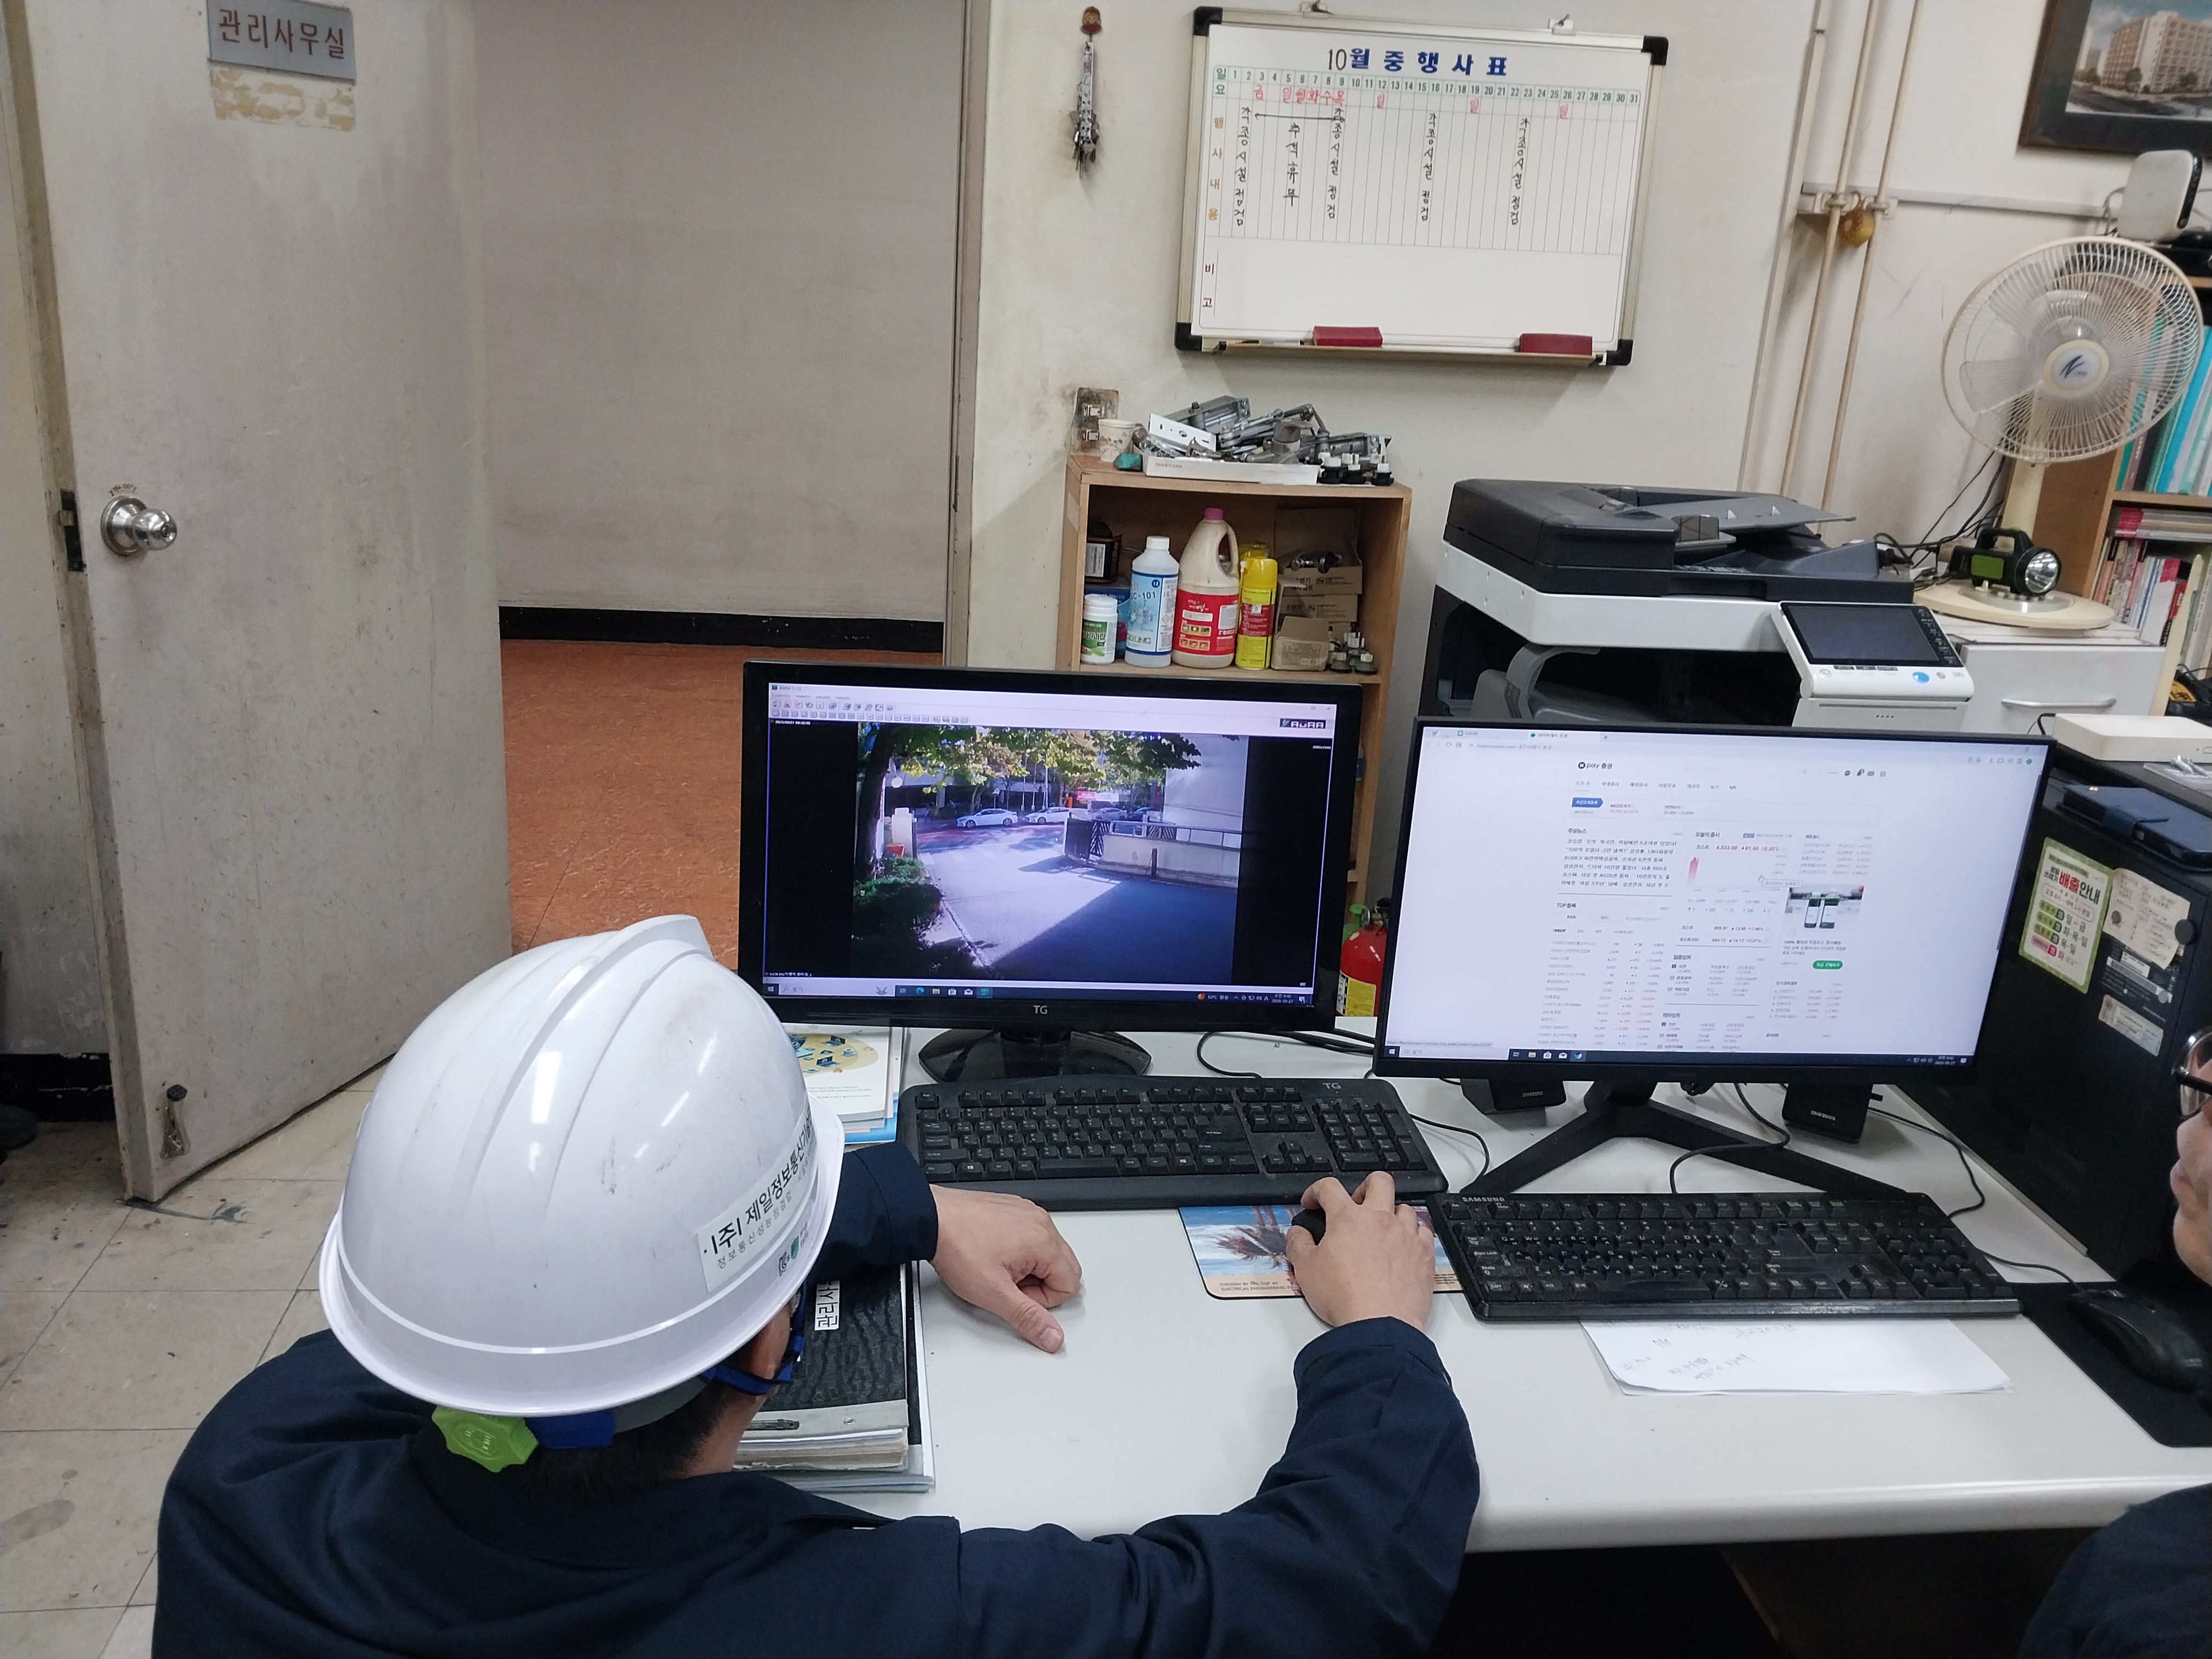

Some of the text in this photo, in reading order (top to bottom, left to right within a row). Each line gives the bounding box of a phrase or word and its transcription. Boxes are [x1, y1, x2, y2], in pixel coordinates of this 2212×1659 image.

[220, 9, 344, 59] 관리사무실
[1215, 84, 1225, 94] 요
[1233, 70, 1237, 79] 1
[1247, 71, 1251, 80] 2
[1259, 72, 1264, 81] 3
[1272, 73, 1277, 81] 4
[1286, 74, 1291, 82] 5
[1300, 74, 1305, 83] 6
[1314, 75, 1318, 84] 7
[1326, 76, 1331, 85] 8
[1340, 77, 1345, 86] 9
[1352, 78, 1360, 87] 10
[1365, 79, 1373, 88] 11
[1378, 80, 1386, 89] 12
[1392, 81, 1399, 89] 13
[1405, 82, 1412, 91] 14
[1418, 82, 1426, 91] 15
[1432, 83, 1439, 92] 16
[1445, 84, 1454, 93] 17
[1458, 85, 1466, 94] 18
[1471, 86, 1479, 94] 19
[1484, 86, 1493, 95] 20
[1497, 87, 1506, 95] 21
[1510, 88, 1519, 97] 22
[1523, 88, 1532, 97] 23
[1538, 89, 1546, 98] 24
[1550, 90, 1559, 99] 25
[1563, 91, 1572, 99] 26
[1577, 91, 1585, 100] 27
[1590, 92, 1598, 100] 28
[1603, 93, 1611, 101] 29
[1616, 93, 1625, 102] 30
[1630, 94, 1638, 103] 31
[1320, 91, 1332, 105] 수
[1033, 1005, 1047, 1014] TG
[1323, 1082, 1341, 1090] TG
[815, 1279, 839, 1328] 관리사
